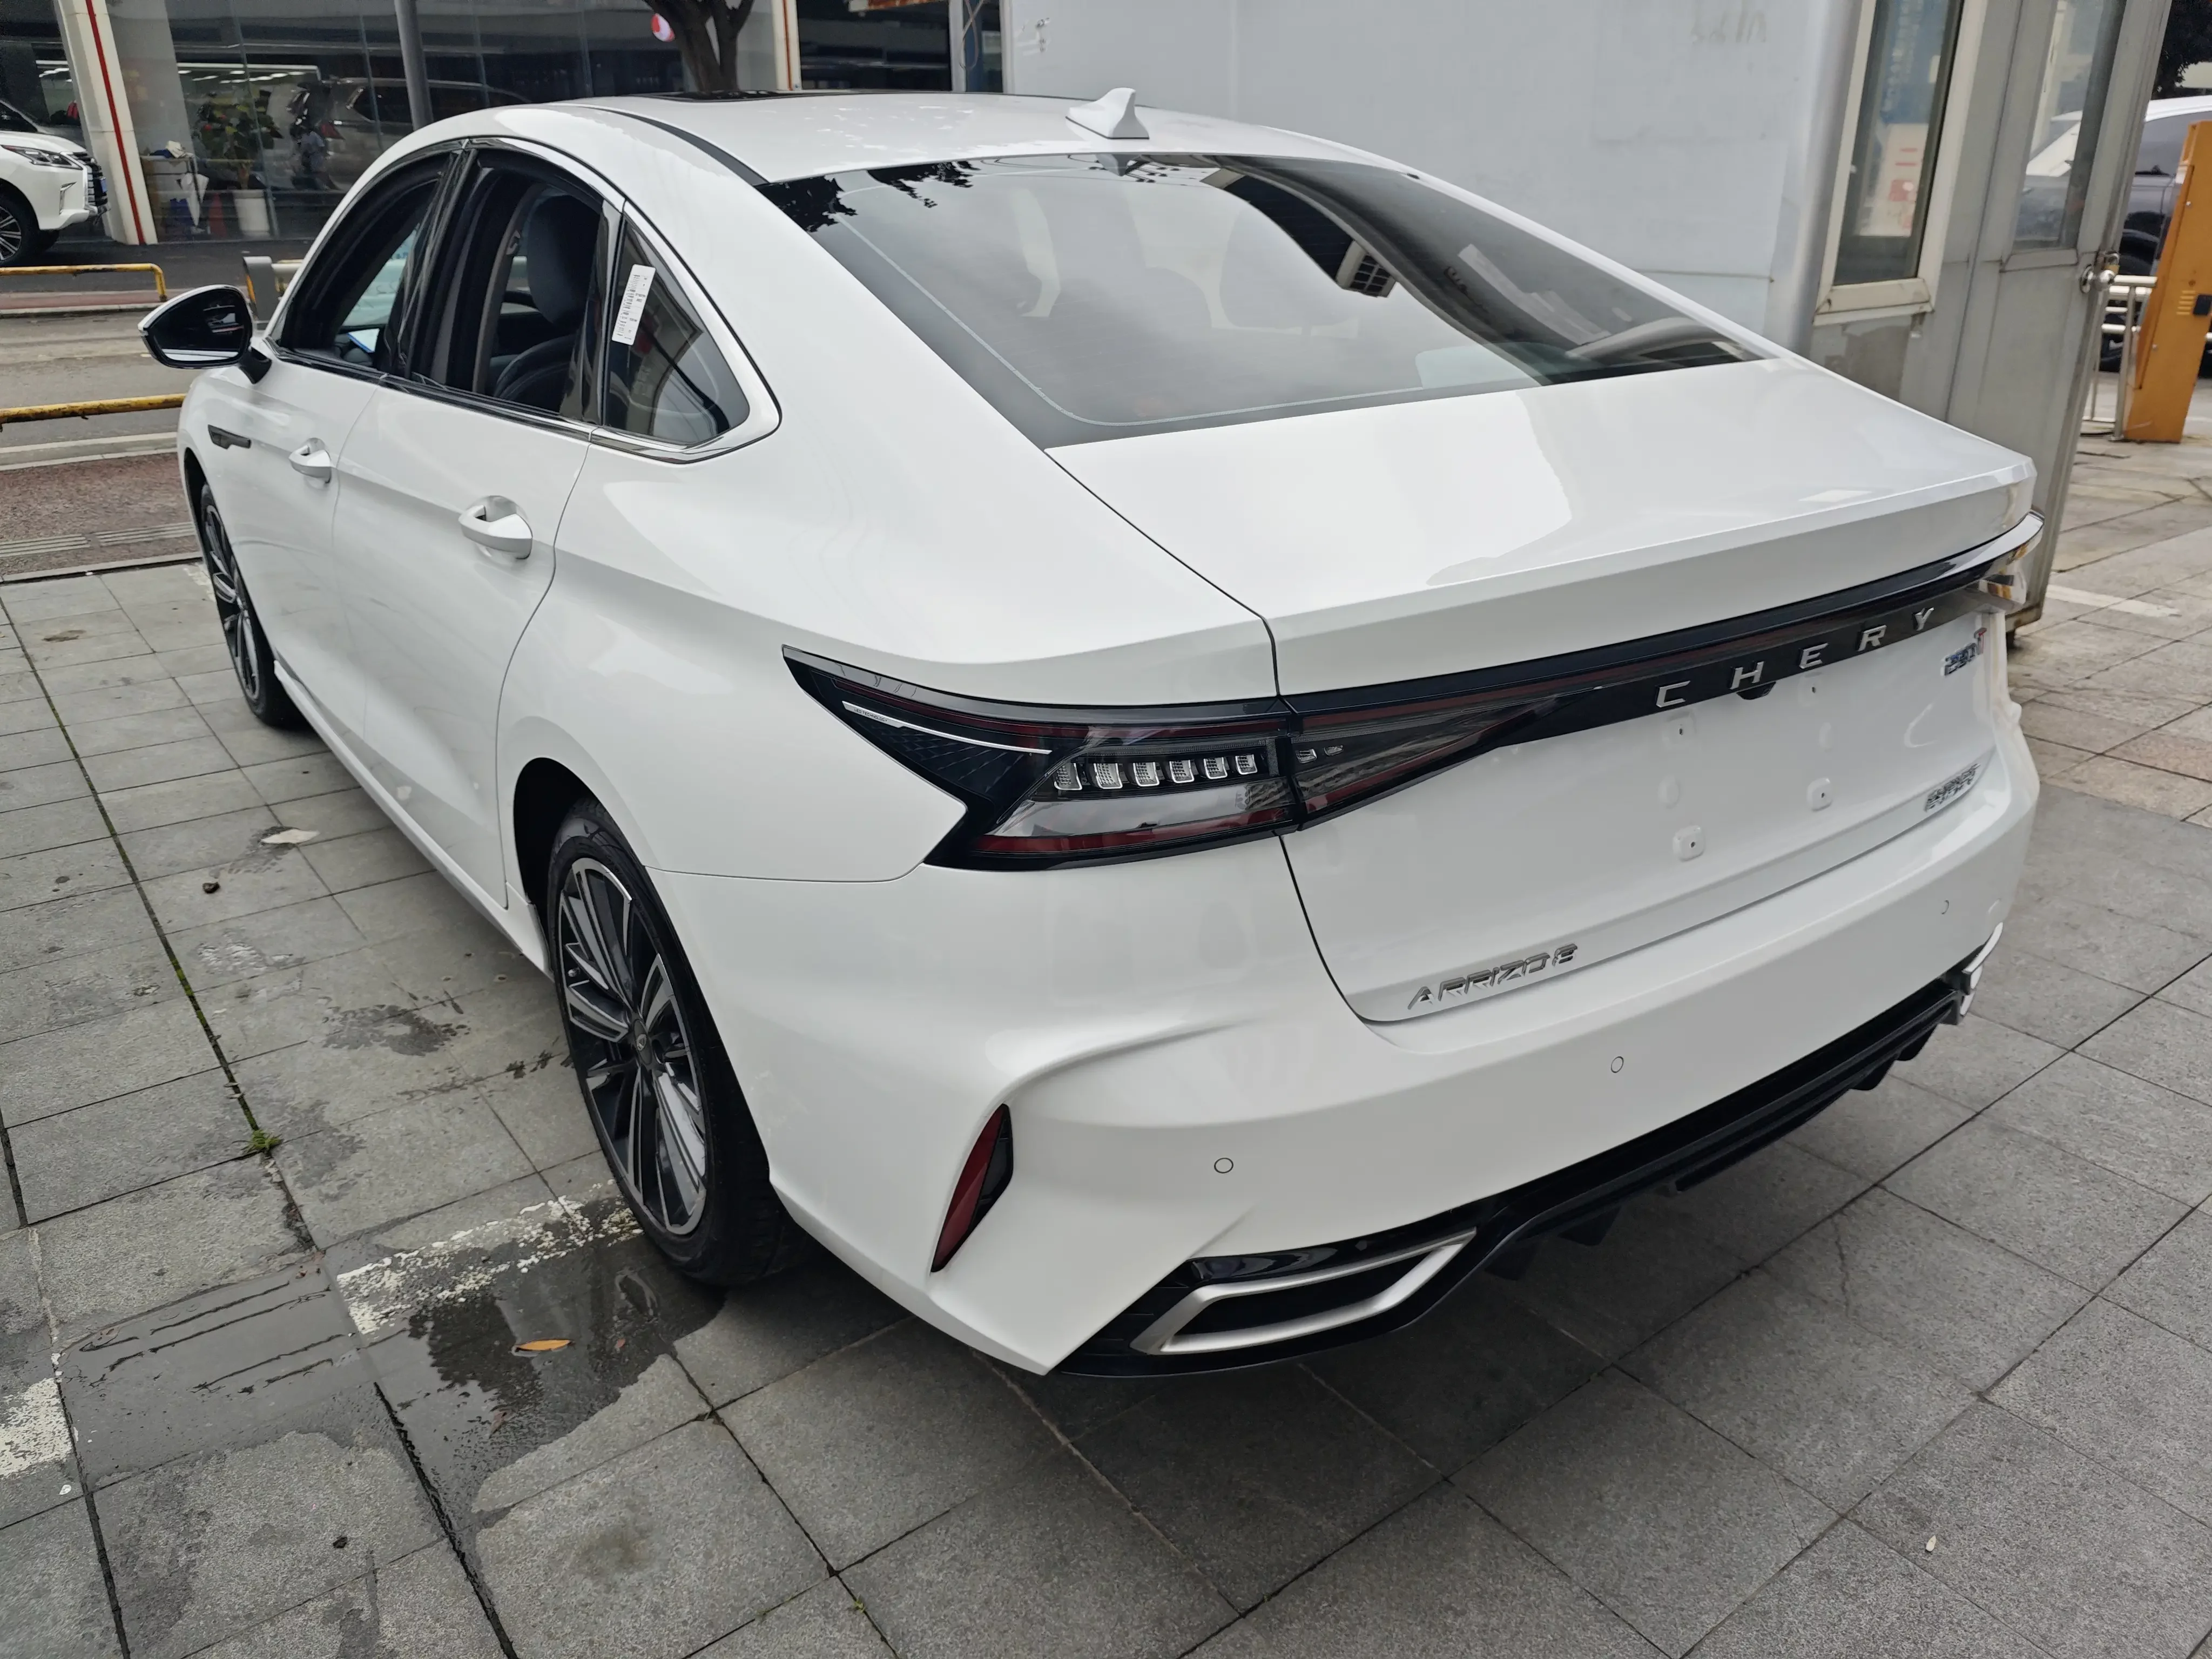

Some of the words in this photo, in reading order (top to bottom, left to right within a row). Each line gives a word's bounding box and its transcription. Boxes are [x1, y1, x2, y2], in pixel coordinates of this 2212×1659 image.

[1656, 606, 1934, 708] CHERY
[1407, 952, 1550, 1010] ARRIZO
[1552, 943, 1578, 967] 8
